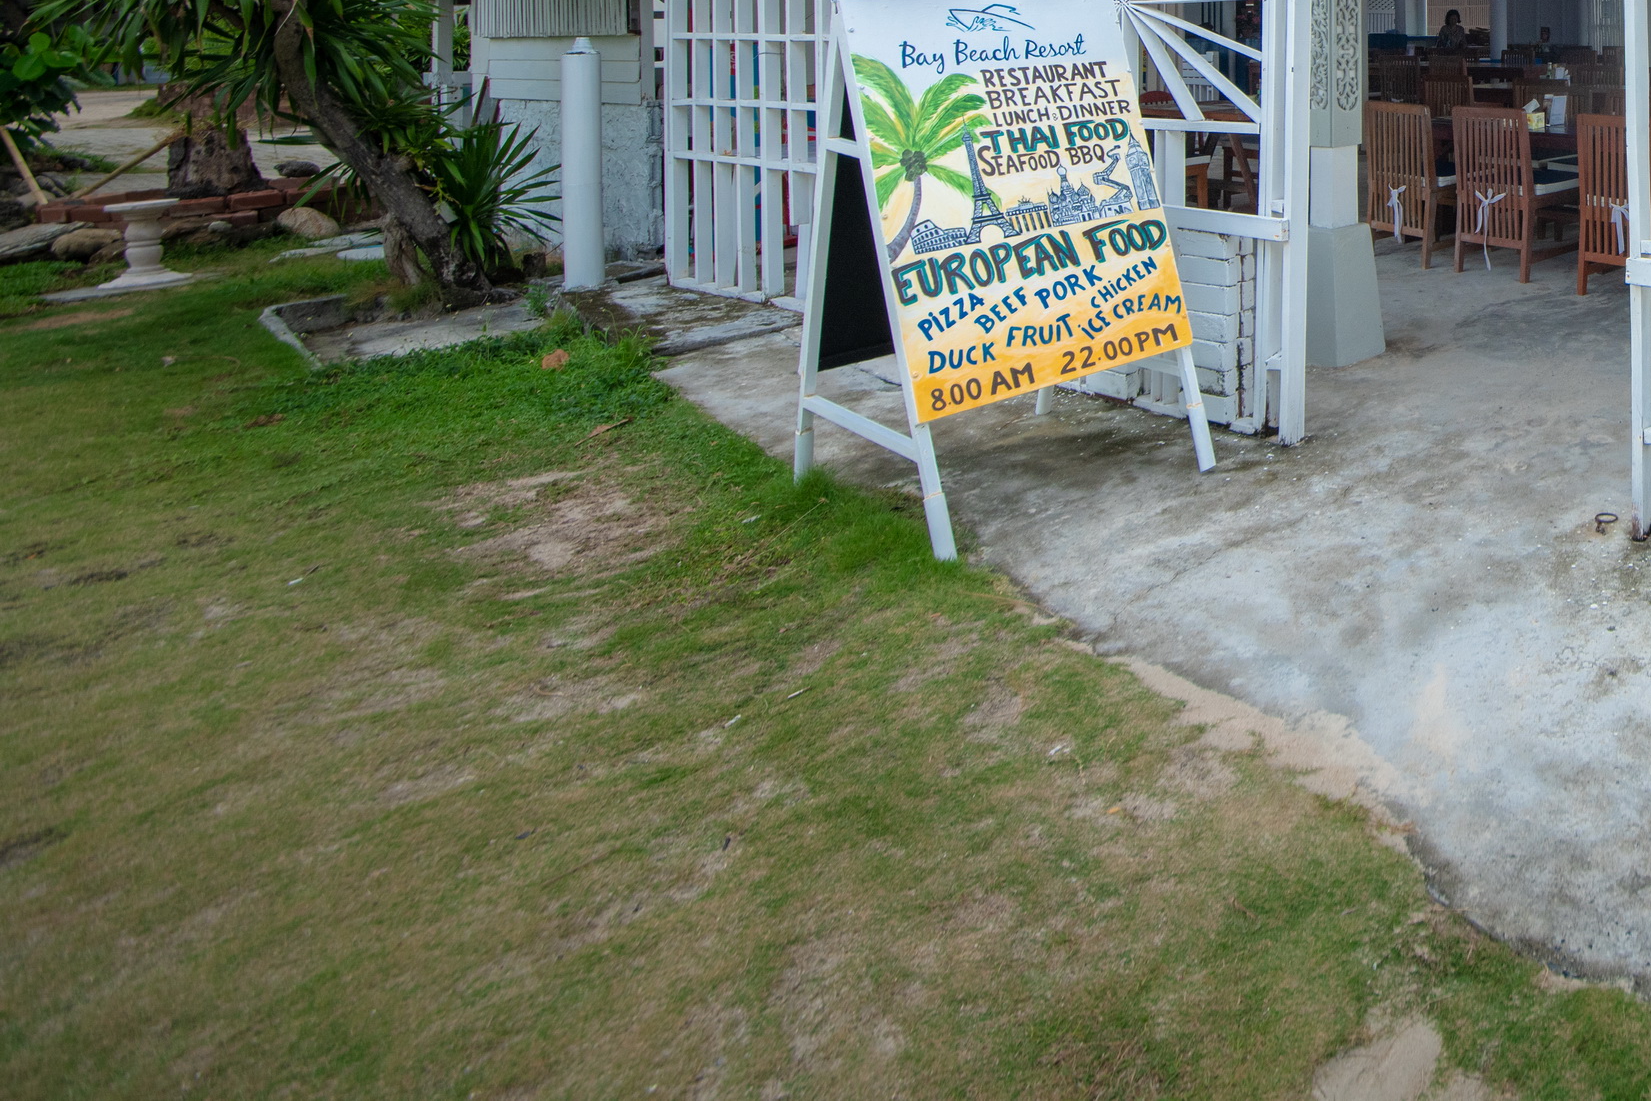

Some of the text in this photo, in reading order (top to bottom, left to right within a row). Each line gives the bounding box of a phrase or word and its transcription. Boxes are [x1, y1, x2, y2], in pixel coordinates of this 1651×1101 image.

[899, 33, 1087, 74] Bay Beach Resort
[980, 61, 1107, 88] RESTAURANT
[986, 80, 1121, 110] BREAKFAST
[992, 107, 1051, 128] LUNCH
[1059, 100, 1131, 122] DINNER
[981, 117, 1129, 155] THAI FOOD
[978, 144, 1108, 176] SEAFOOD BBQ
[891, 219, 1167, 307] EUROPEAN FOOD
[974, 287, 1029, 334] BEEF
[1033, 264, 1104, 310] PORK
[928, 342, 997, 374] DUCK
[1005, 313, 1074, 348] FRUIT
[1112, 293, 1182, 320] CREAM
[930, 378, 982, 412] 8.00
[990, 362, 1035, 395] AM
[1135, 323, 1179, 353] PM
